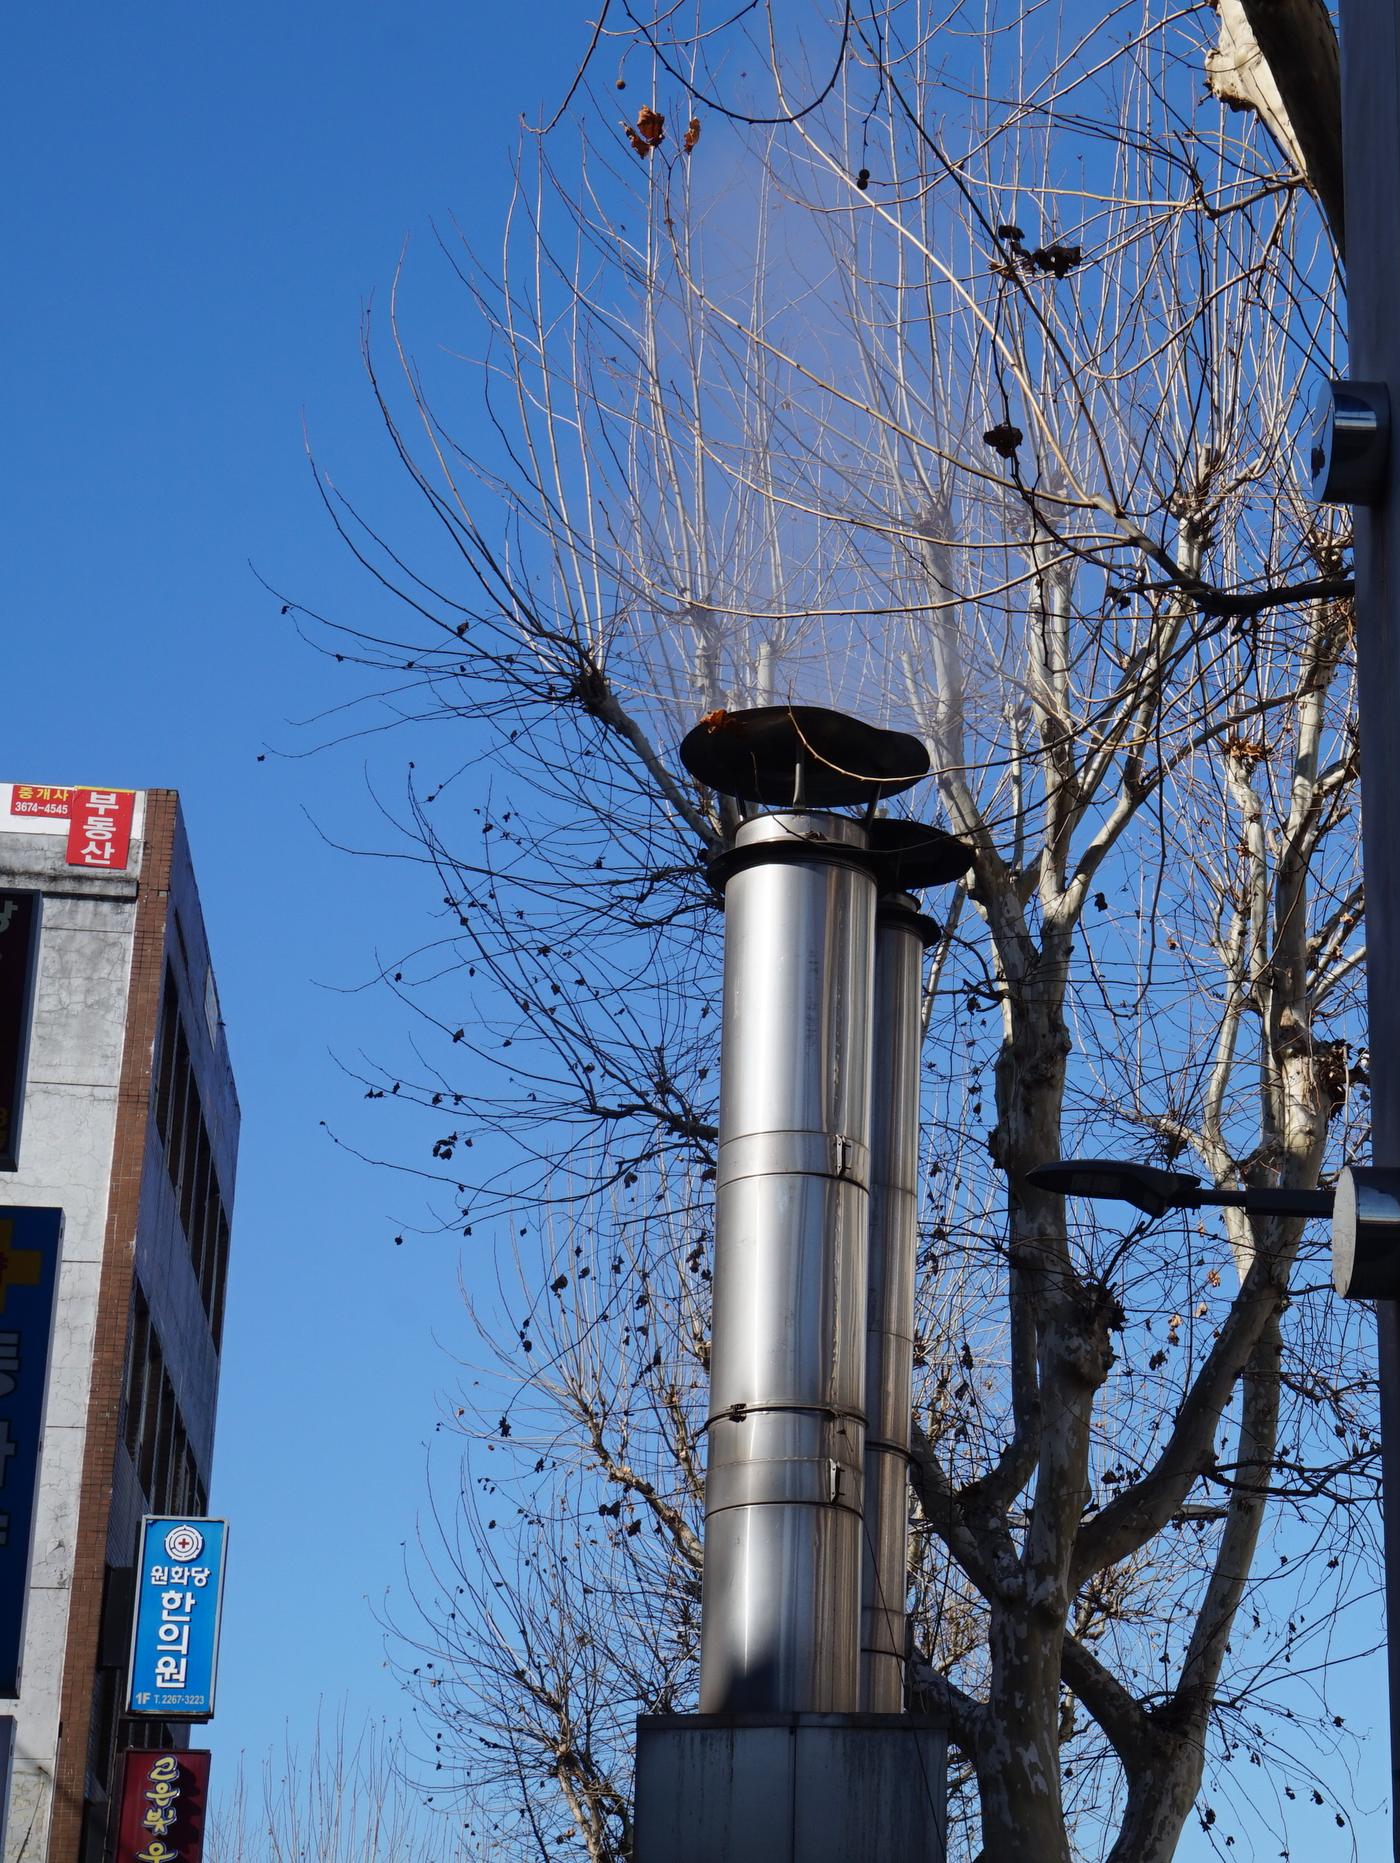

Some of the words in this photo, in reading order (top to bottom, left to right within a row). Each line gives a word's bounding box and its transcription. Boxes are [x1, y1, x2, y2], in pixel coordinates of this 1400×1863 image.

[18, 786, 70, 802] 중개사
[15, 801, 69, 815] 3674-4545
[80, 791, 120, 866] 부동산
[150, 1565, 211, 1588] 원화당
[155, 1590, 196, 1688] 한의원
[135, 1692, 152, 1705] 1F
